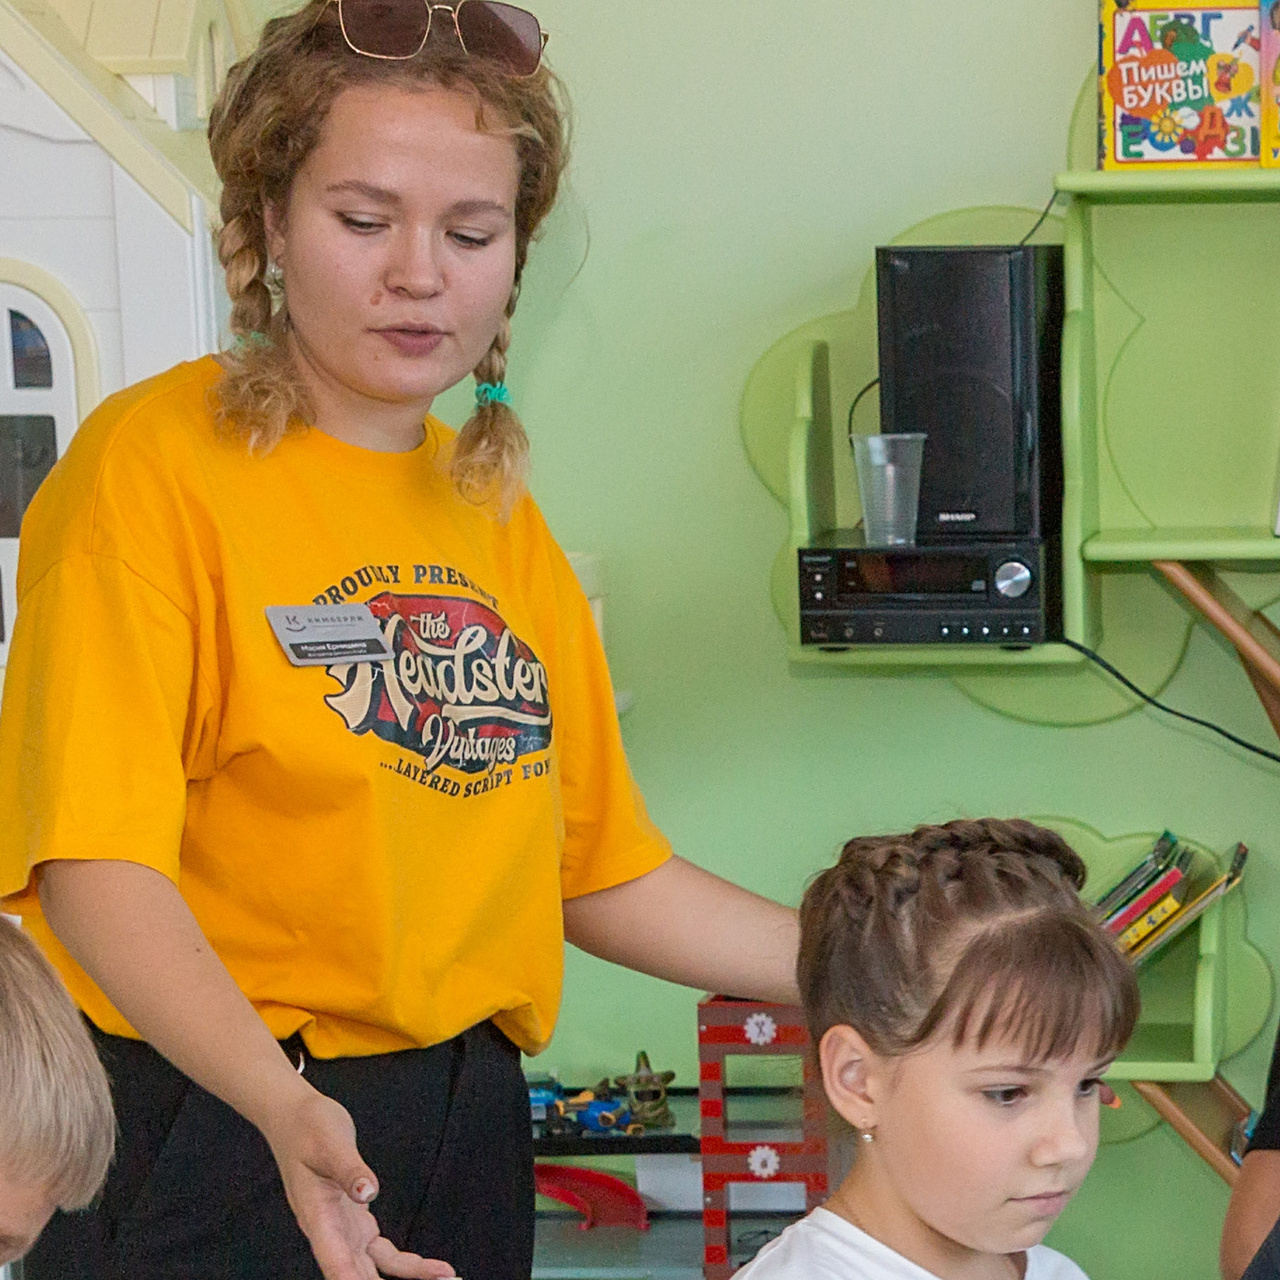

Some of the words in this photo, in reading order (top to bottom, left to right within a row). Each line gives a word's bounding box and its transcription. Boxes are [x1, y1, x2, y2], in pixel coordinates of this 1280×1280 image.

[1118, 59, 1208, 85] Пишем
[1122, 76, 1210, 109] БУКВЫ
[410, 612, 451, 640] the
[463, 769, 513, 799] SCRIPT
